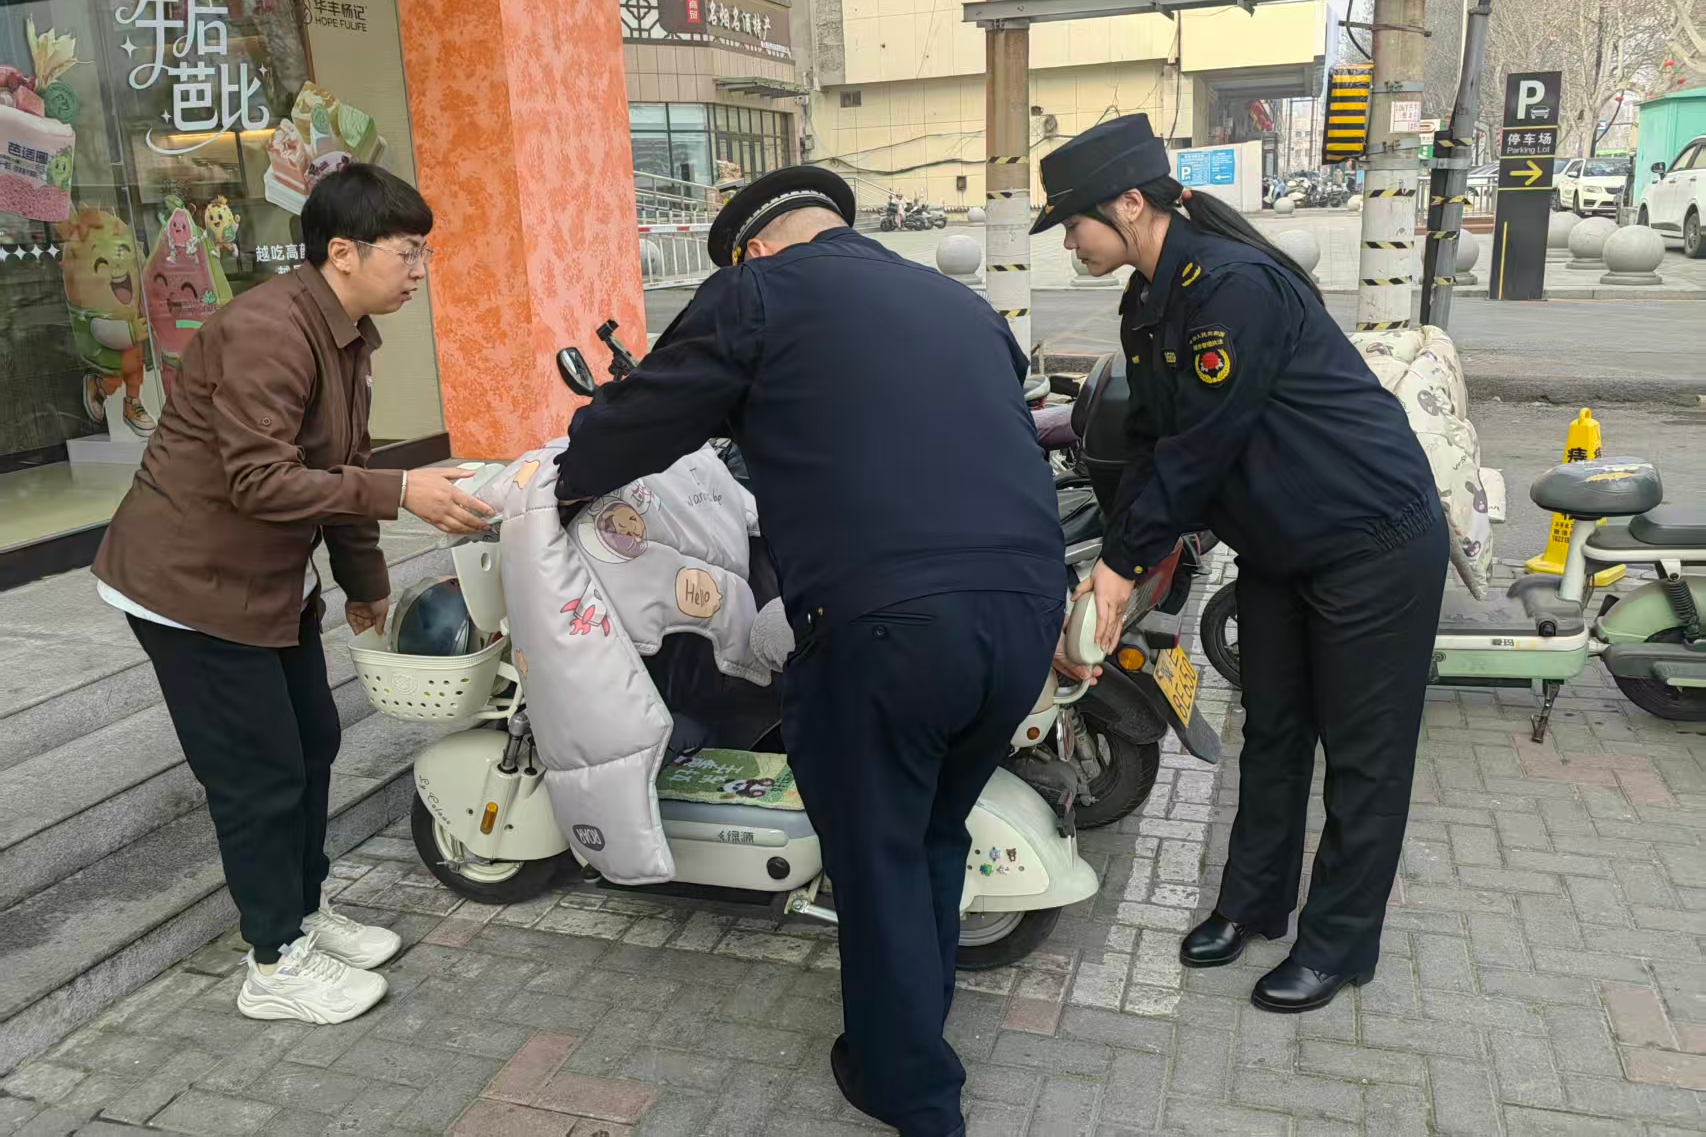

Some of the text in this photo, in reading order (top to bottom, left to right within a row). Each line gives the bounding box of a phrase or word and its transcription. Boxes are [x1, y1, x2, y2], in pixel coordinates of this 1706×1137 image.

[166, 62, 269, 134] 芭比
[1517, 80, 1545, 119] P
[1507, 132, 1552, 146] 停车场
[1507, 146, 1535, 154] Parking
[1181, 166, 1191, 180] P
[685, 578, 711, 606] Hello
[575, 828, 603, 845] ROAR
[726, 830, 755, 844] 绿源
